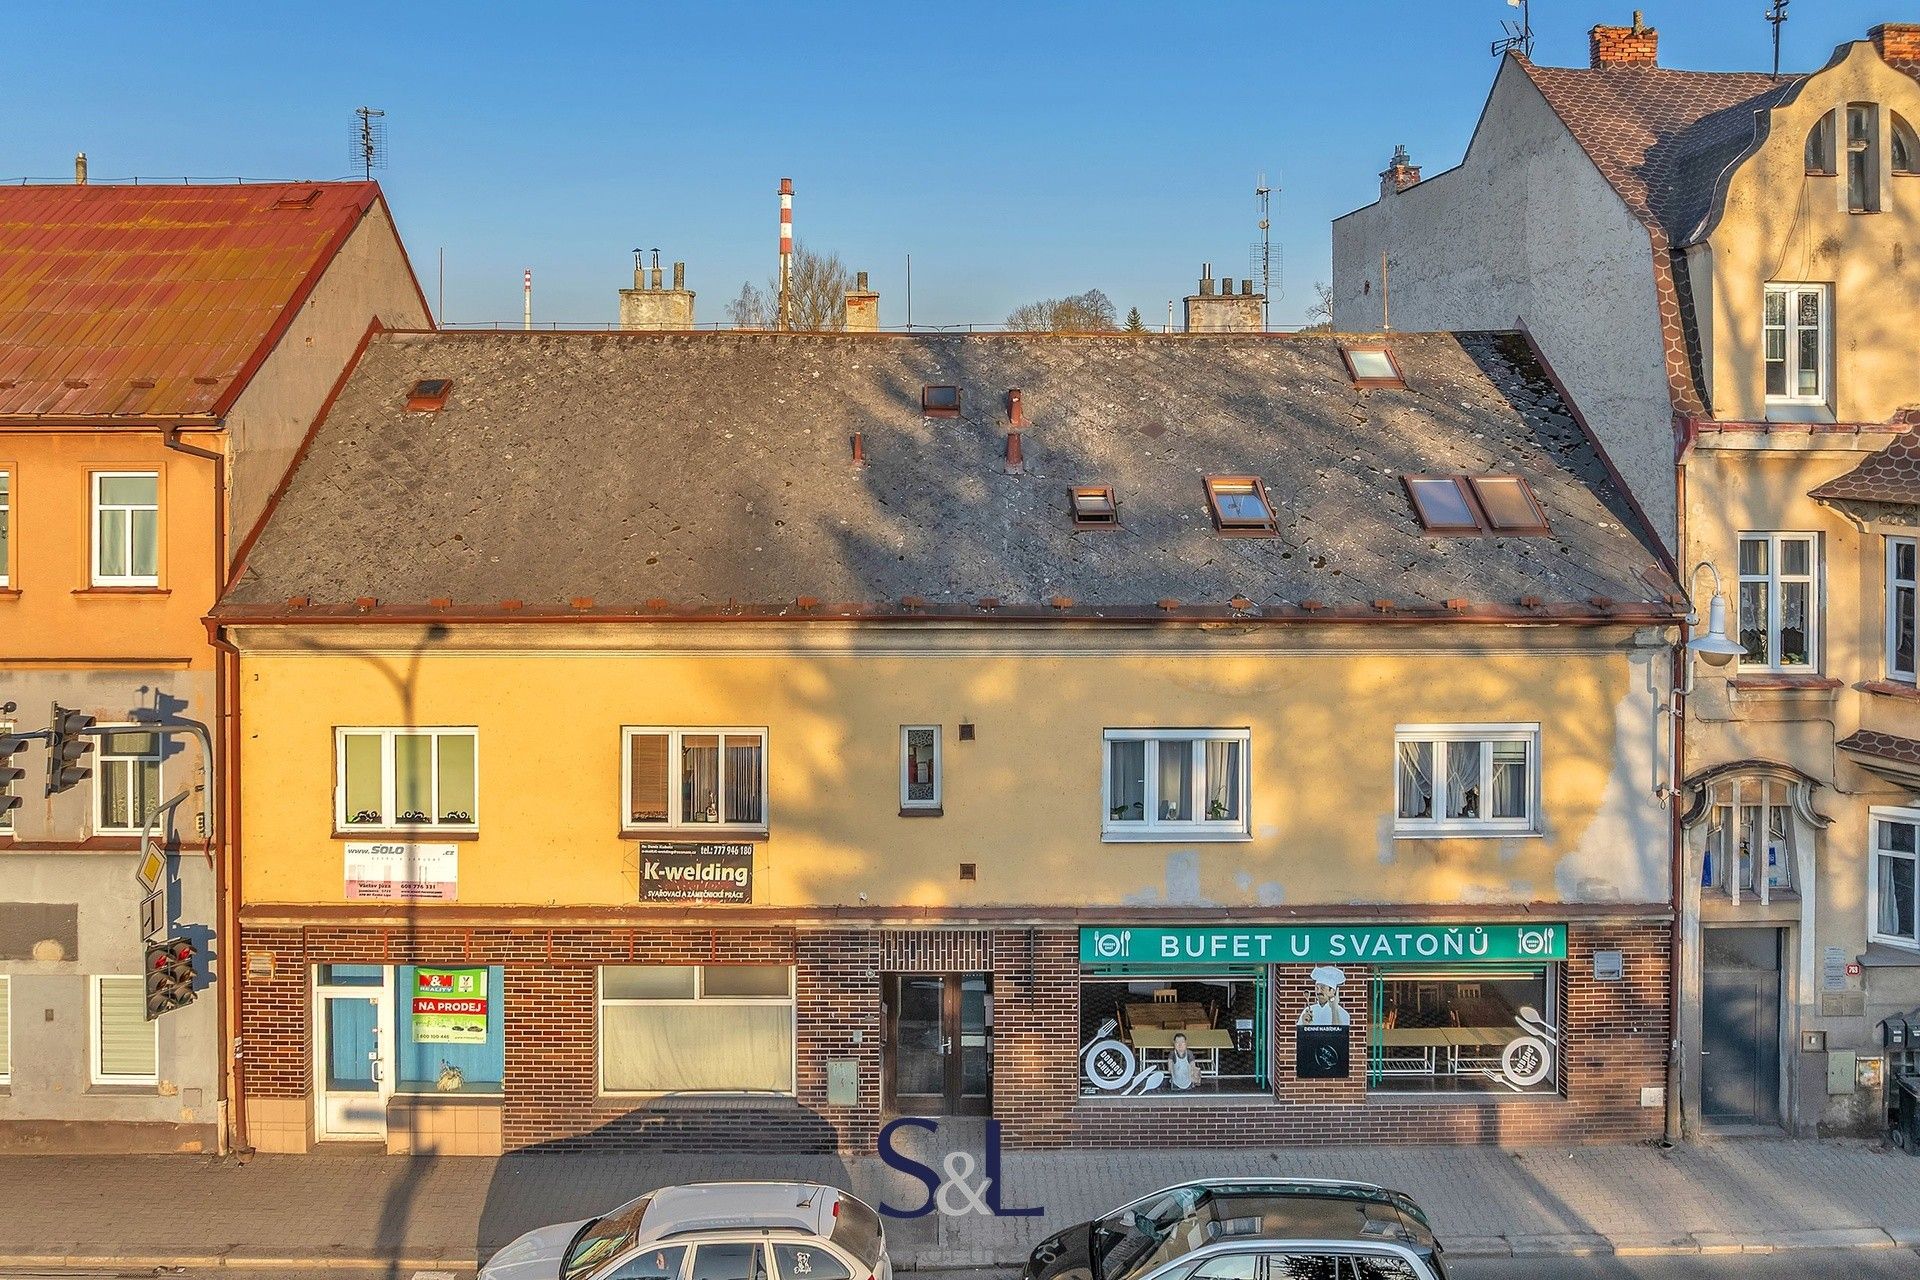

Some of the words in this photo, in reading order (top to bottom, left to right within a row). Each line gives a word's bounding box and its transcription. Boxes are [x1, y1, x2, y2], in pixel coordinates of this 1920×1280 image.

[714, 846, 726, 855] 777
[727, 846, 739, 855] 946
[740, 846, 752, 855] 180
[644, 862, 748, 887] K-welding
[1161, 934, 1272, 958] BUFET
[1290, 934, 1310, 957] U
[1329, 927, 1488, 957] SVATOŇŮ
[418, 1001, 436, 1011] NA
[437, 1002, 482, 1012] PRODEJ
[1100, 1050, 1124, 1076] DOBROU
[1512, 1046, 1535, 1075] DOBROU
